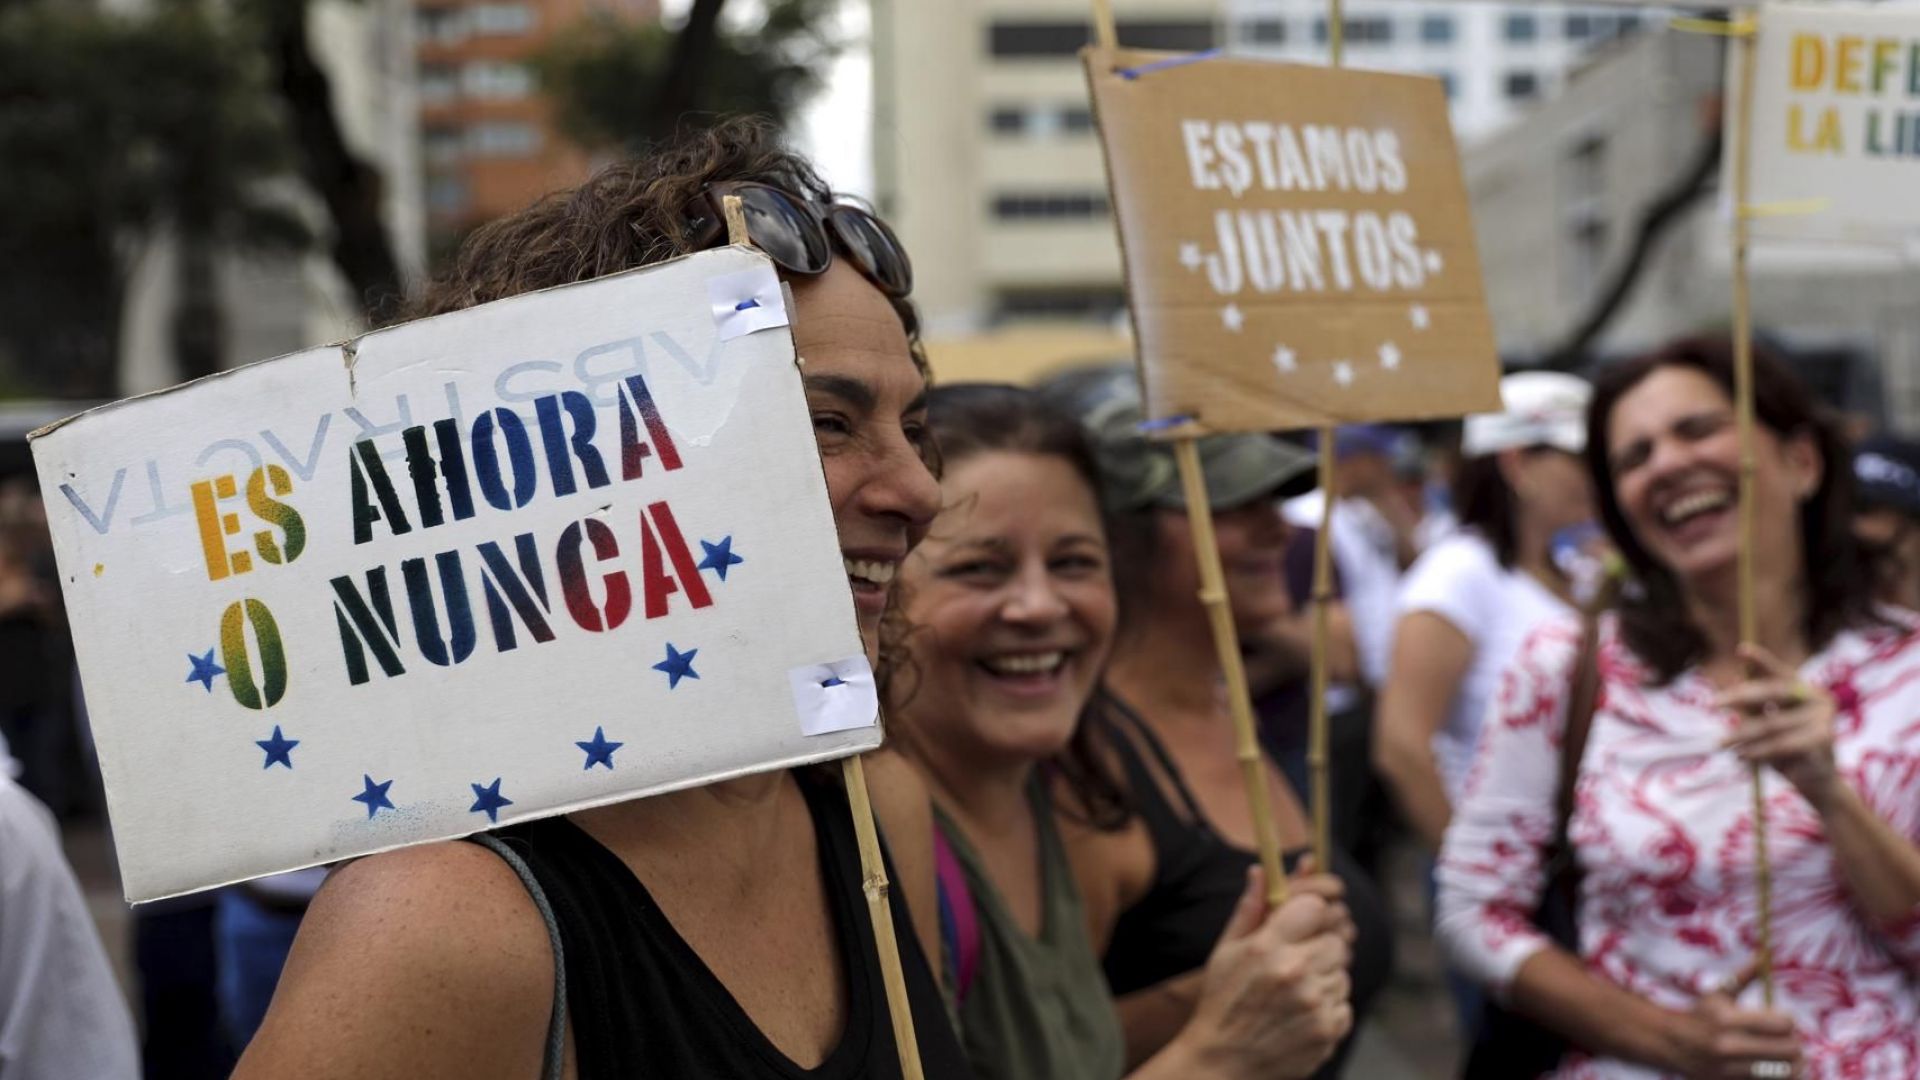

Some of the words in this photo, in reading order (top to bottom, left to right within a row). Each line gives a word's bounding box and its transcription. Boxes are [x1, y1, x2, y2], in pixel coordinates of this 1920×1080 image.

[1180, 119, 1407, 193] ESTAMOS
[1787, 102, 1845, 156] LA
[1865, 107, 1920, 159] LI
[1205, 208, 1424, 294] JUNTOS
[191, 463, 307, 582] ES
[350, 375, 684, 545] AHORA
[219, 597, 288, 710] O
[330, 500, 713, 686] NUNCA
